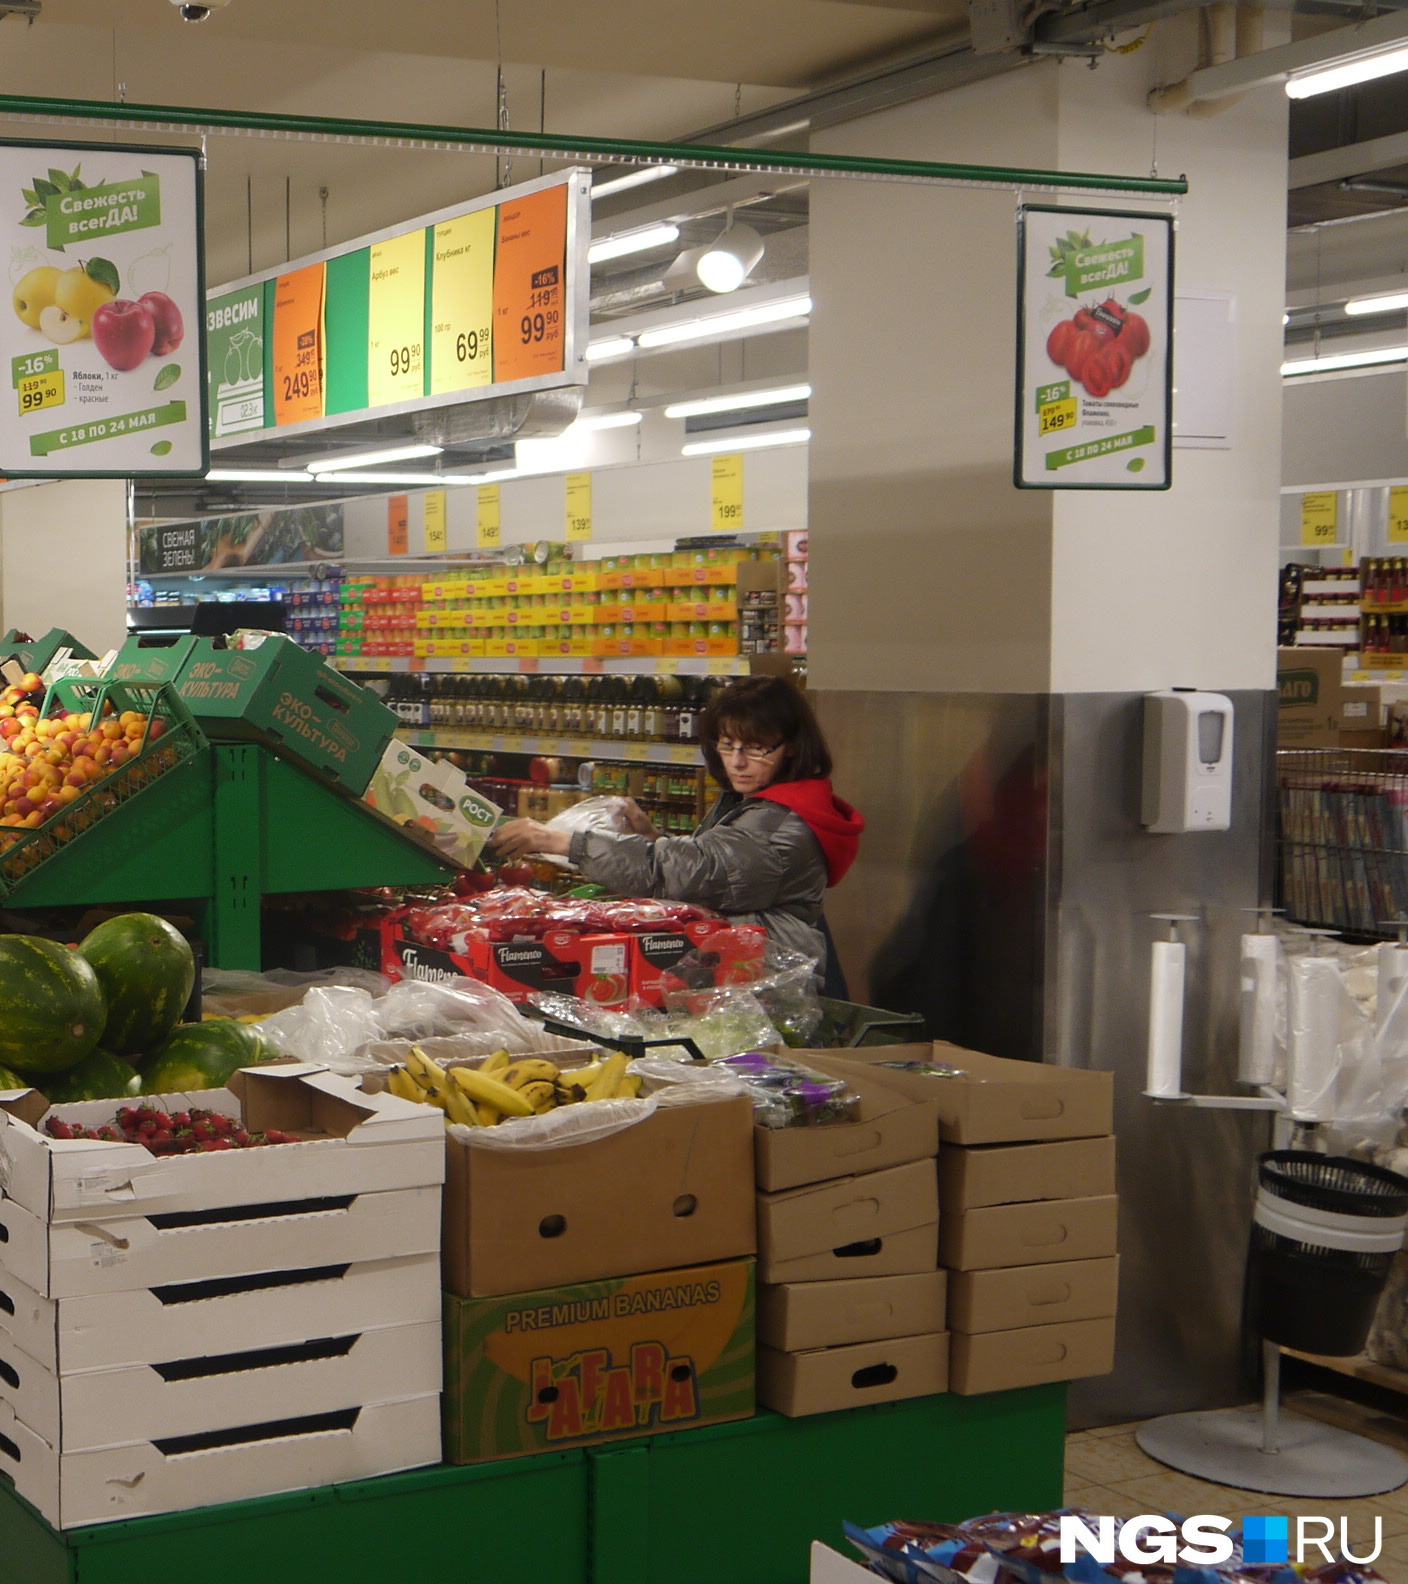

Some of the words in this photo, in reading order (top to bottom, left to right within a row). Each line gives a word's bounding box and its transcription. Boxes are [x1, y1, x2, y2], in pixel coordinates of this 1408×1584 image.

[59, 187, 146, 215] Свежесть
[69, 205, 138, 233] всегДА!
[436, 246, 464, 262] Клубника
[465, 244, 471, 253] кг
[1075, 249, 1136, 267] Свежесть
[371, 270, 389, 282] Арбуз
[1081, 261, 1129, 284] всегДА!
[207, 297, 258, 331] звесим
[435, 324, 444, 333] 100
[521, 312, 545, 345] 99
[546, 310, 559, 325] 90
[456, 331, 478, 362] 69
[18, 354, 53, 375] -16%
[390, 347, 410, 376] 99
[411, 344, 421, 357] 90
[72, 371, 104, 381] Яблоки,
[110, 373, 119, 381] кг
[283, 371, 309, 401] 249
[23, 381, 39, 392] 119
[78, 383, 103, 393] Голден
[22, 391, 43, 409] 99
[45, 388, 57, 398] 90
[79, 395, 109, 404] красные
[1082, 399, 1102, 407] Томаты
[59, 434, 67, 444] С
[71, 430, 86, 443] 18
[89, 426, 106, 438] ПО
[110, 421, 126, 433] 24
[129, 413, 156, 428] МАЯ
[1042, 414, 1064, 431] 149
[1065, 412, 1074, 421] 90
[1066, 451, 1072, 461] С
[1075, 448, 1085, 459] 18
[1086, 445, 1099, 457] ПО
[1101, 440, 1111, 452] 24
[1114, 435, 1134, 448] МАЯ
[718, 505, 736, 519] 199
[163, 530, 195, 548] СВЕЖАЯ
[189, 662, 223, 679] ЭКО-
[178, 681, 240, 699] КУЛЬТУРА
[280, 691, 322, 723] ЭКО-
[273, 704, 347, 763] КУЛЬТУРА
[462, 798, 493, 823] РОСТ
[642, 936, 684, 952] Flamenco
[498, 947, 542, 963] Flamenco
[505, 1297, 610, 1333] PREMIUM
[615, 1281, 722, 1317] BANANAS
